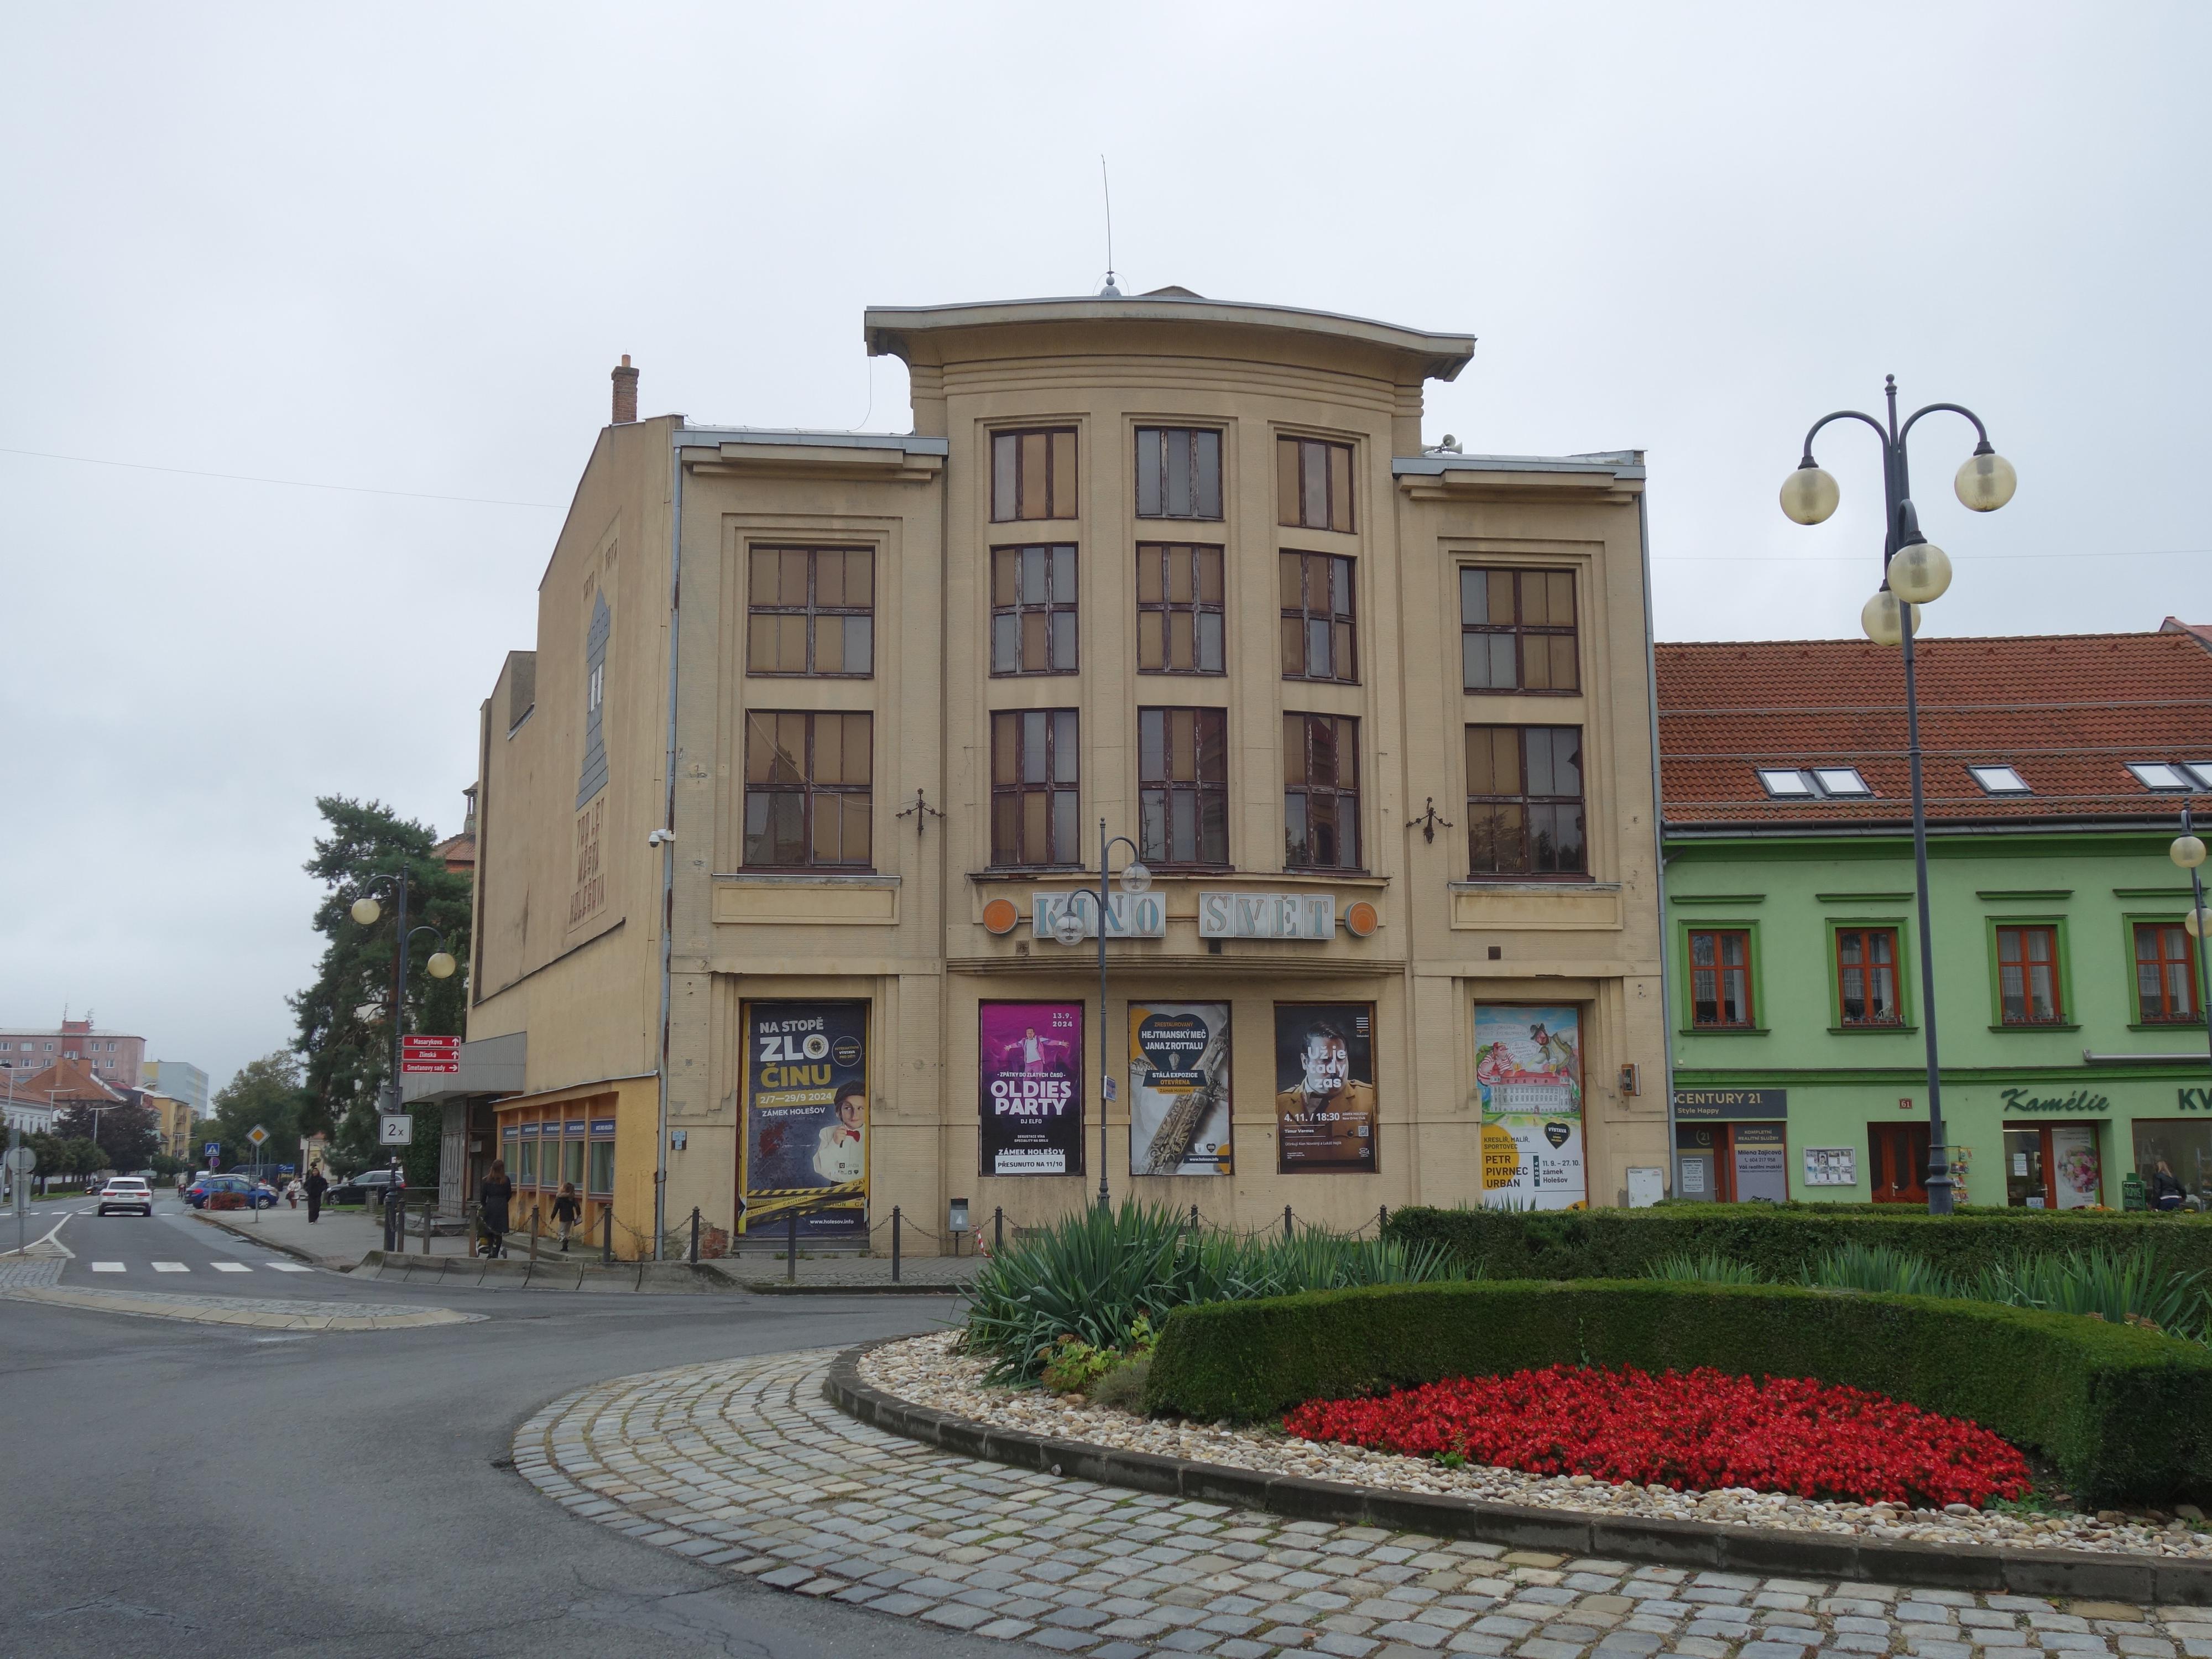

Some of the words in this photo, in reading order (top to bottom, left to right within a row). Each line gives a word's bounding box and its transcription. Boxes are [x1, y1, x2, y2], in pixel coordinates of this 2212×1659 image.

[577, 811, 589, 849] 700
[591, 797, 604, 836] LET
[577, 839, 599, 884] MĚSTA
[569, 874, 604, 925] HOLEŠOVA
[1036, 895, 1159, 935] KINO
[1207, 895, 1328, 936] SVĚT
[760, 1022, 779, 1034] NA
[782, 1016, 824, 1032] STOPĚ
[1141, 1029, 1190, 1039] HEJTMANSKÝ
[1191, 1029, 1206, 1039] MEČ
[760, 1034, 829, 1062] ZLO
[1308, 1046, 1328, 1059] Už
[1332, 1046, 1346, 1062] je
[760, 1062, 831, 1088] ČINU
[1308, 1059, 1345, 1077] tady
[990, 1080, 1072, 1098] OLDIES
[1314, 1078, 1342, 1088] zas
[808, 1093, 832, 1101] 2024
[1677, 1093, 1744, 1104] CENTURY
[2001, 1088, 2109, 1112] Kamélie
[790, 1107, 825, 1115] HOLEŠOV
[995, 1098, 1067, 1115] PARTY
[1295, 1113, 1308, 1121] 11.
[1316, 1113, 1340, 1121] 18:30
[1486, 1155, 1511, 1164] PETR
[1486, 1167, 1528, 1176] PIVRNEC
[1486, 1179, 1520, 1188] URBAN
[784, 1197, 807, 1206] CAUTION
